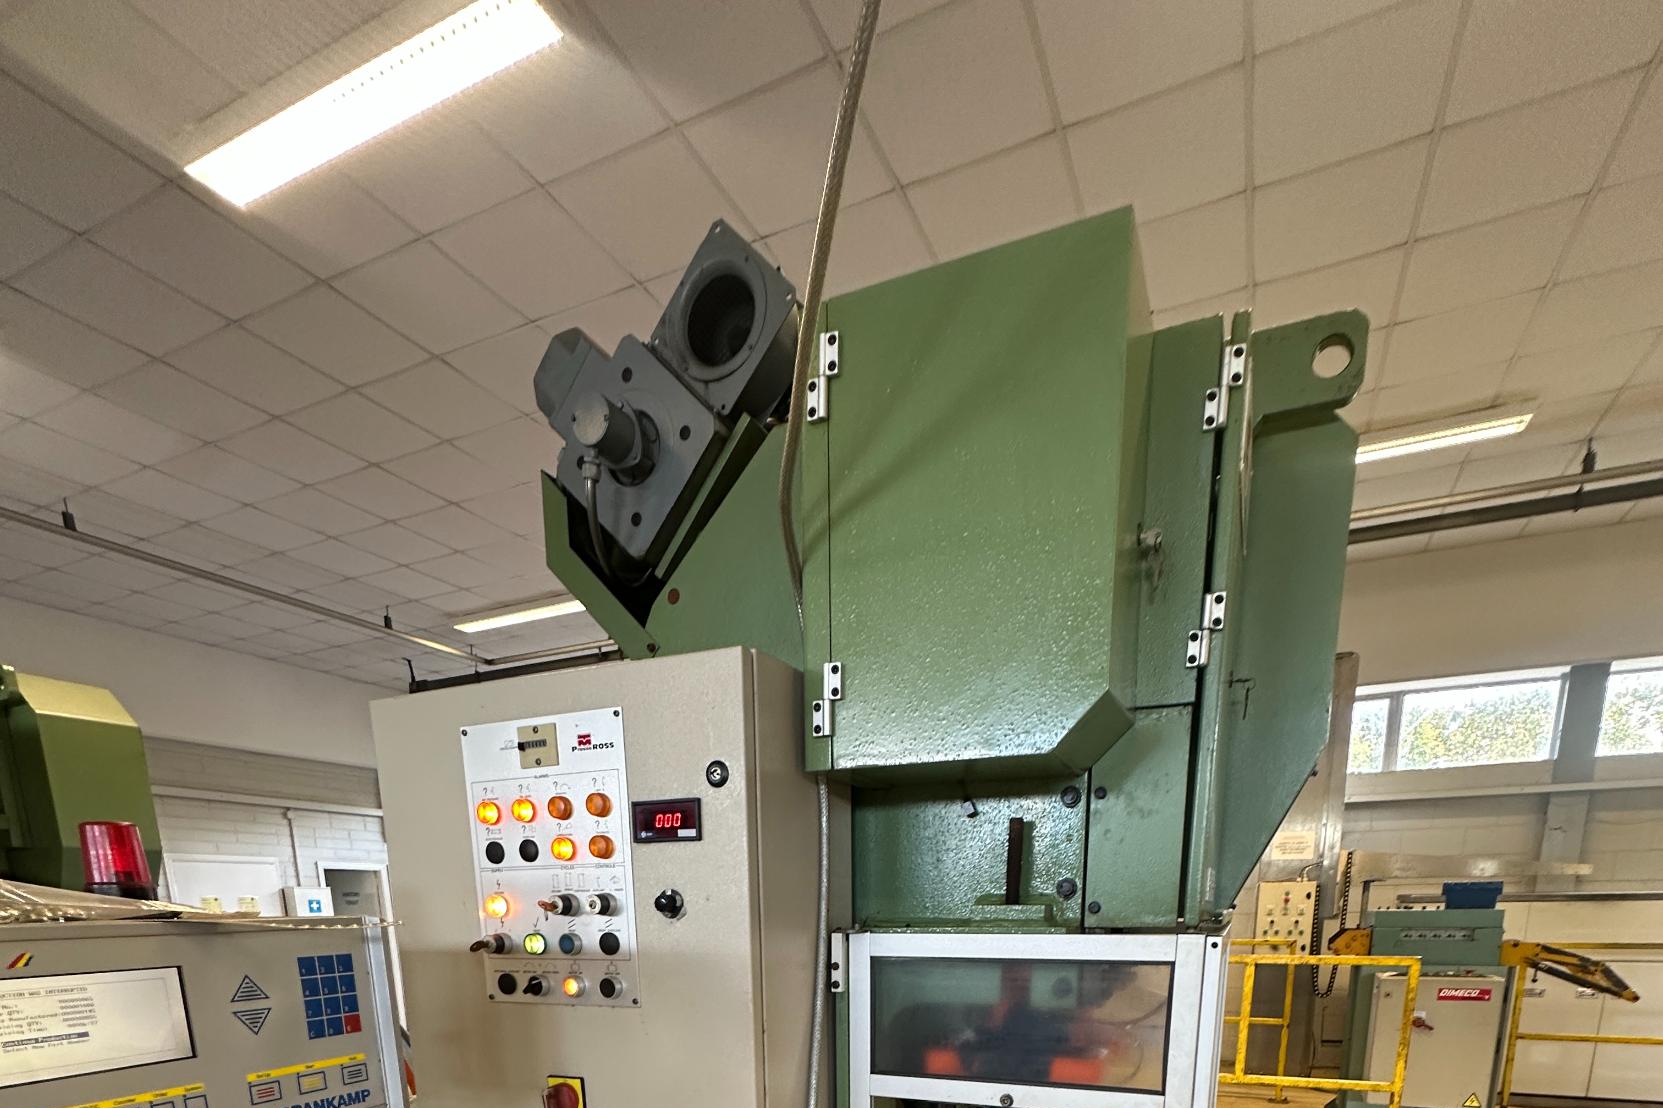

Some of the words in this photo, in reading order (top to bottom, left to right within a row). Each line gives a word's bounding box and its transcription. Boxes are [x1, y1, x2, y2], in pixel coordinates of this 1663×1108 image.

[593, 742, 614, 750] ROSS
[655, 812, 682, 828] 000
[1439, 989, 1480, 997] DIMECO
